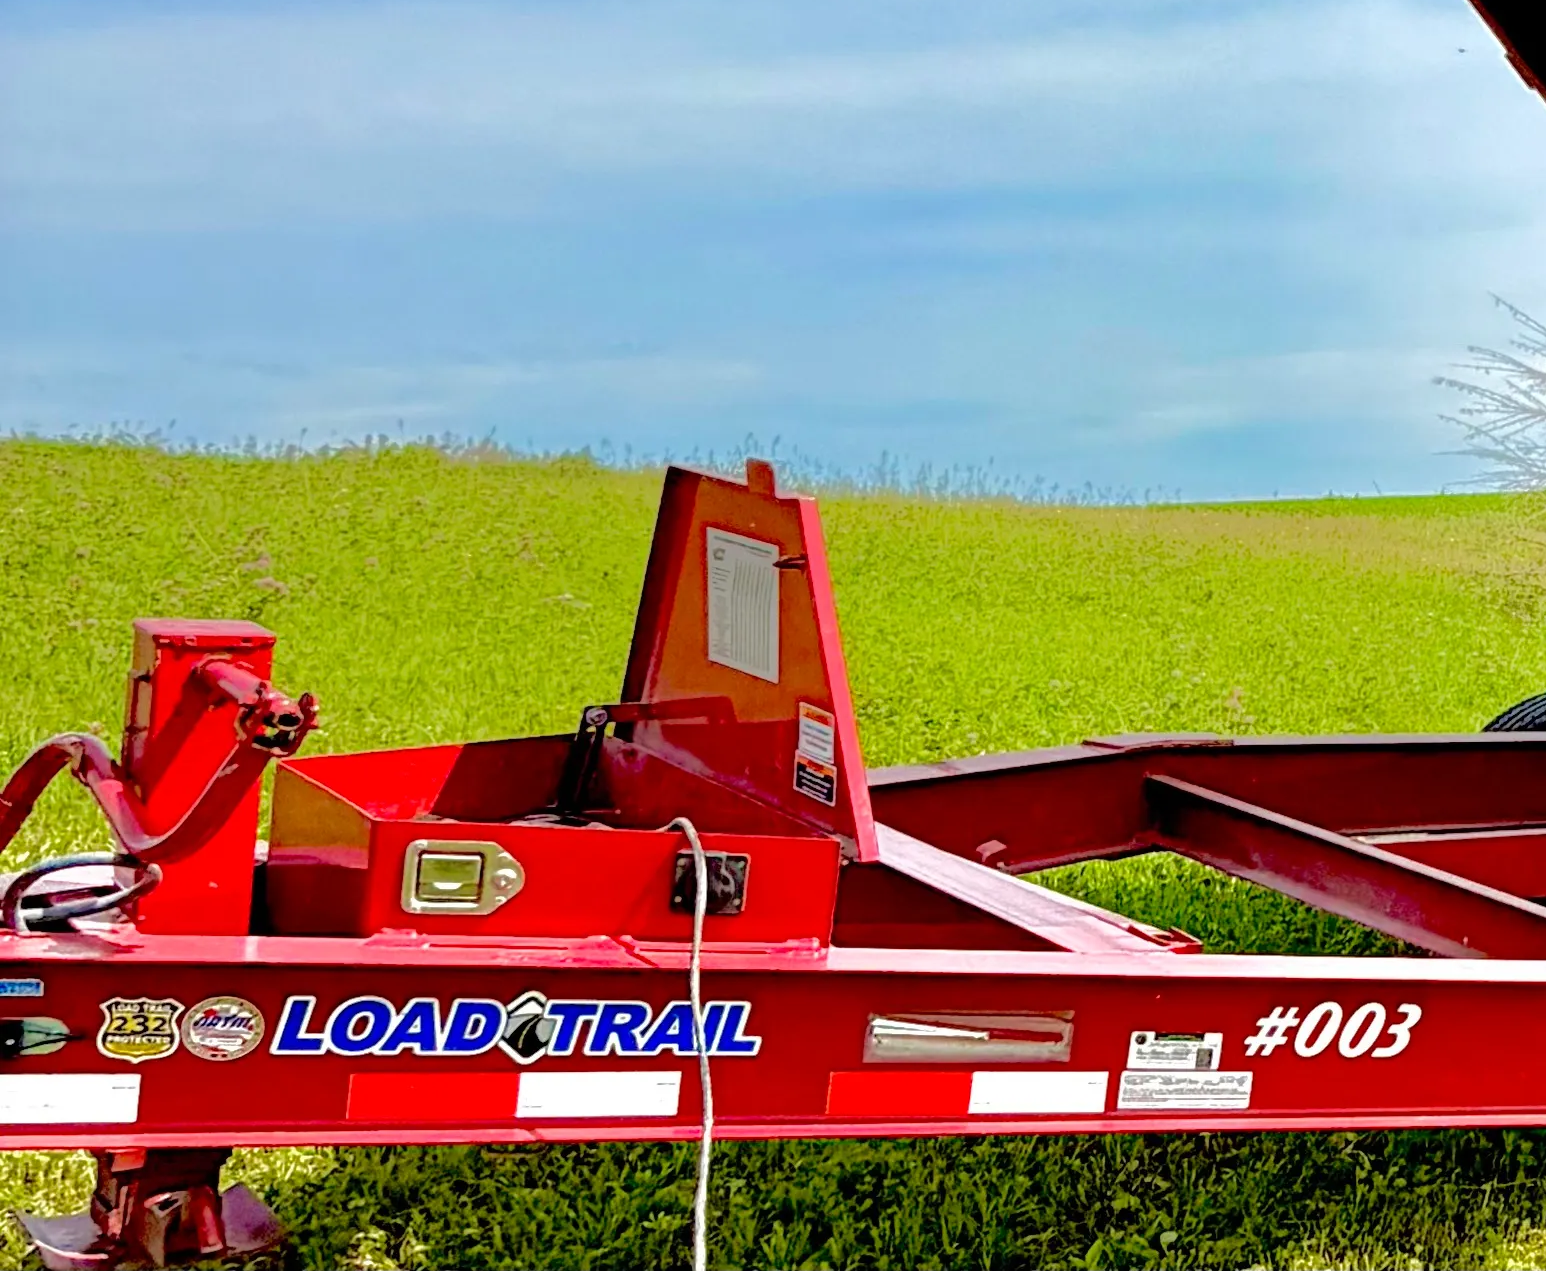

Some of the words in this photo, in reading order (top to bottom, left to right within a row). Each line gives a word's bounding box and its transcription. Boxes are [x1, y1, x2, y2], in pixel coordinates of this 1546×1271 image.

[114, 1014, 167, 1035] 232
[270, 995, 507, 1058] LOAD
[541, 999, 763, 1057] TRAIL
[1243, 1001, 1423, 1060] #003
